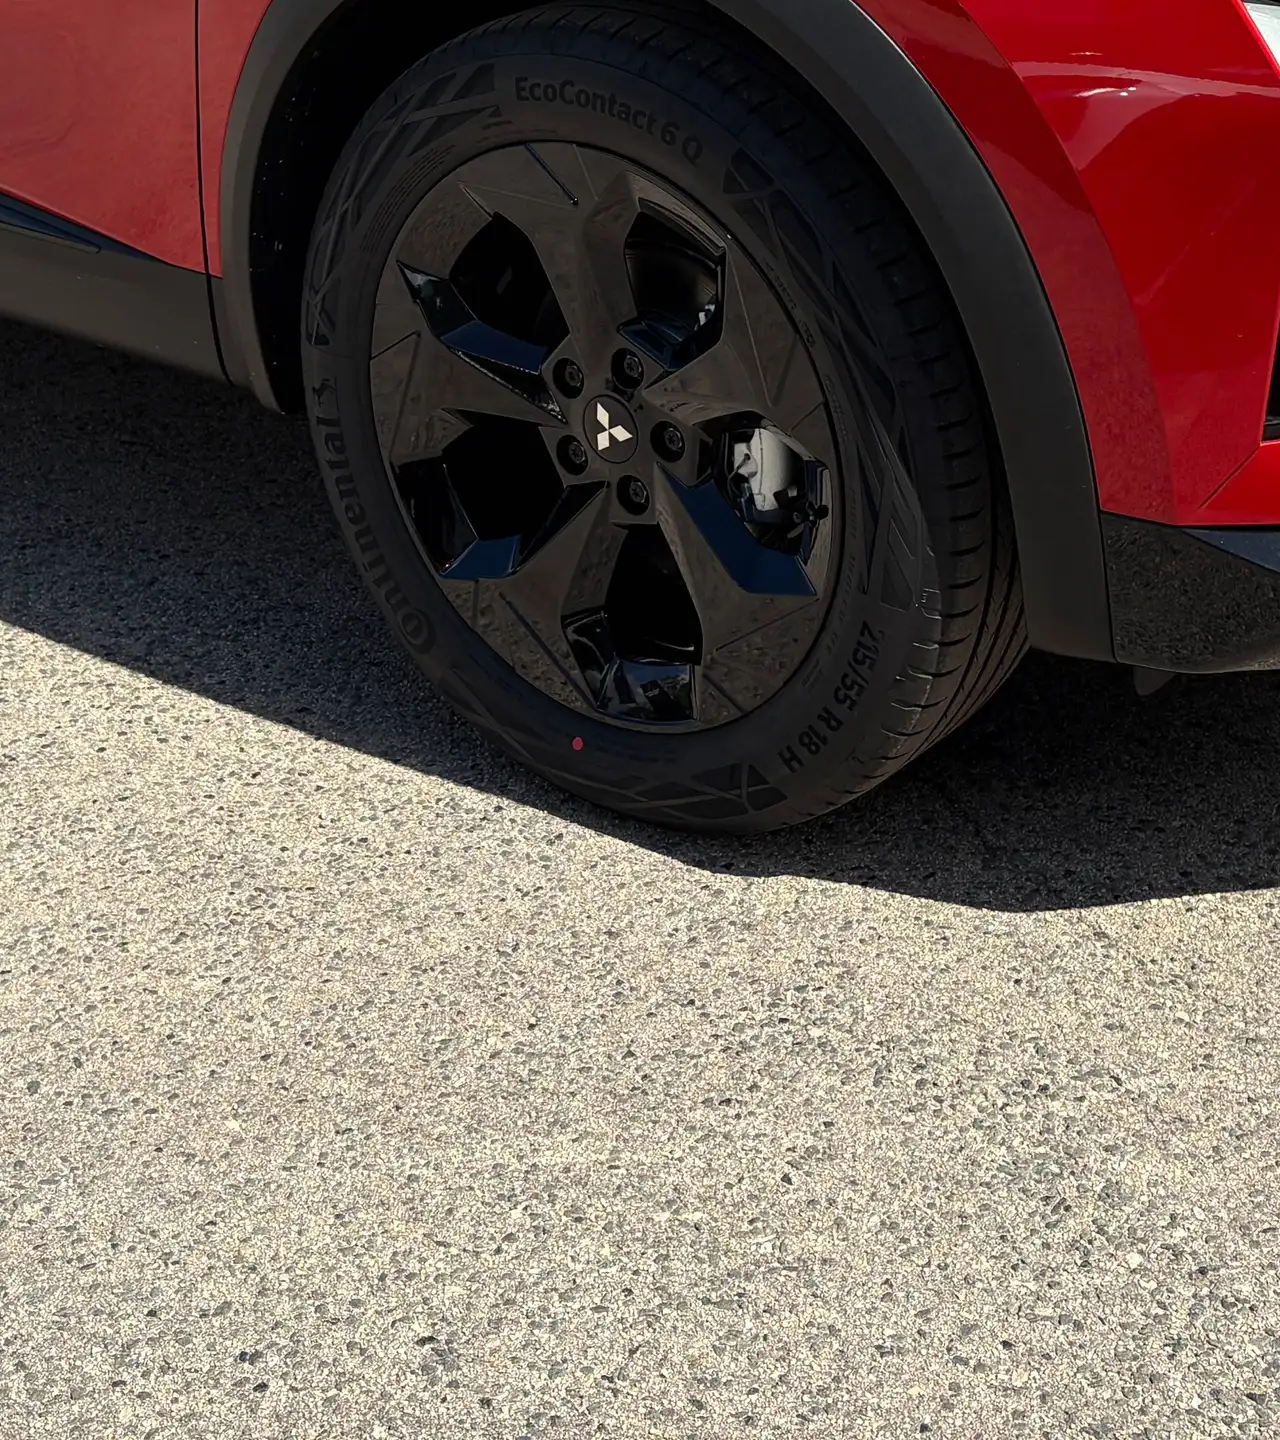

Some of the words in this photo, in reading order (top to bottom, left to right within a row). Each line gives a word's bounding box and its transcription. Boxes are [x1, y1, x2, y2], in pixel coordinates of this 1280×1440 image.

[513, 75, 658, 137] EcoContact
[660, 120, 680, 147] 6
[681, 134, 703, 168] Q
[315, 413, 436, 654] Continental
[833, 619, 886, 712] 215/55
[798, 724, 829, 757] 18
[816, 705, 844, 732] R
[776, 744, 805, 774] H
